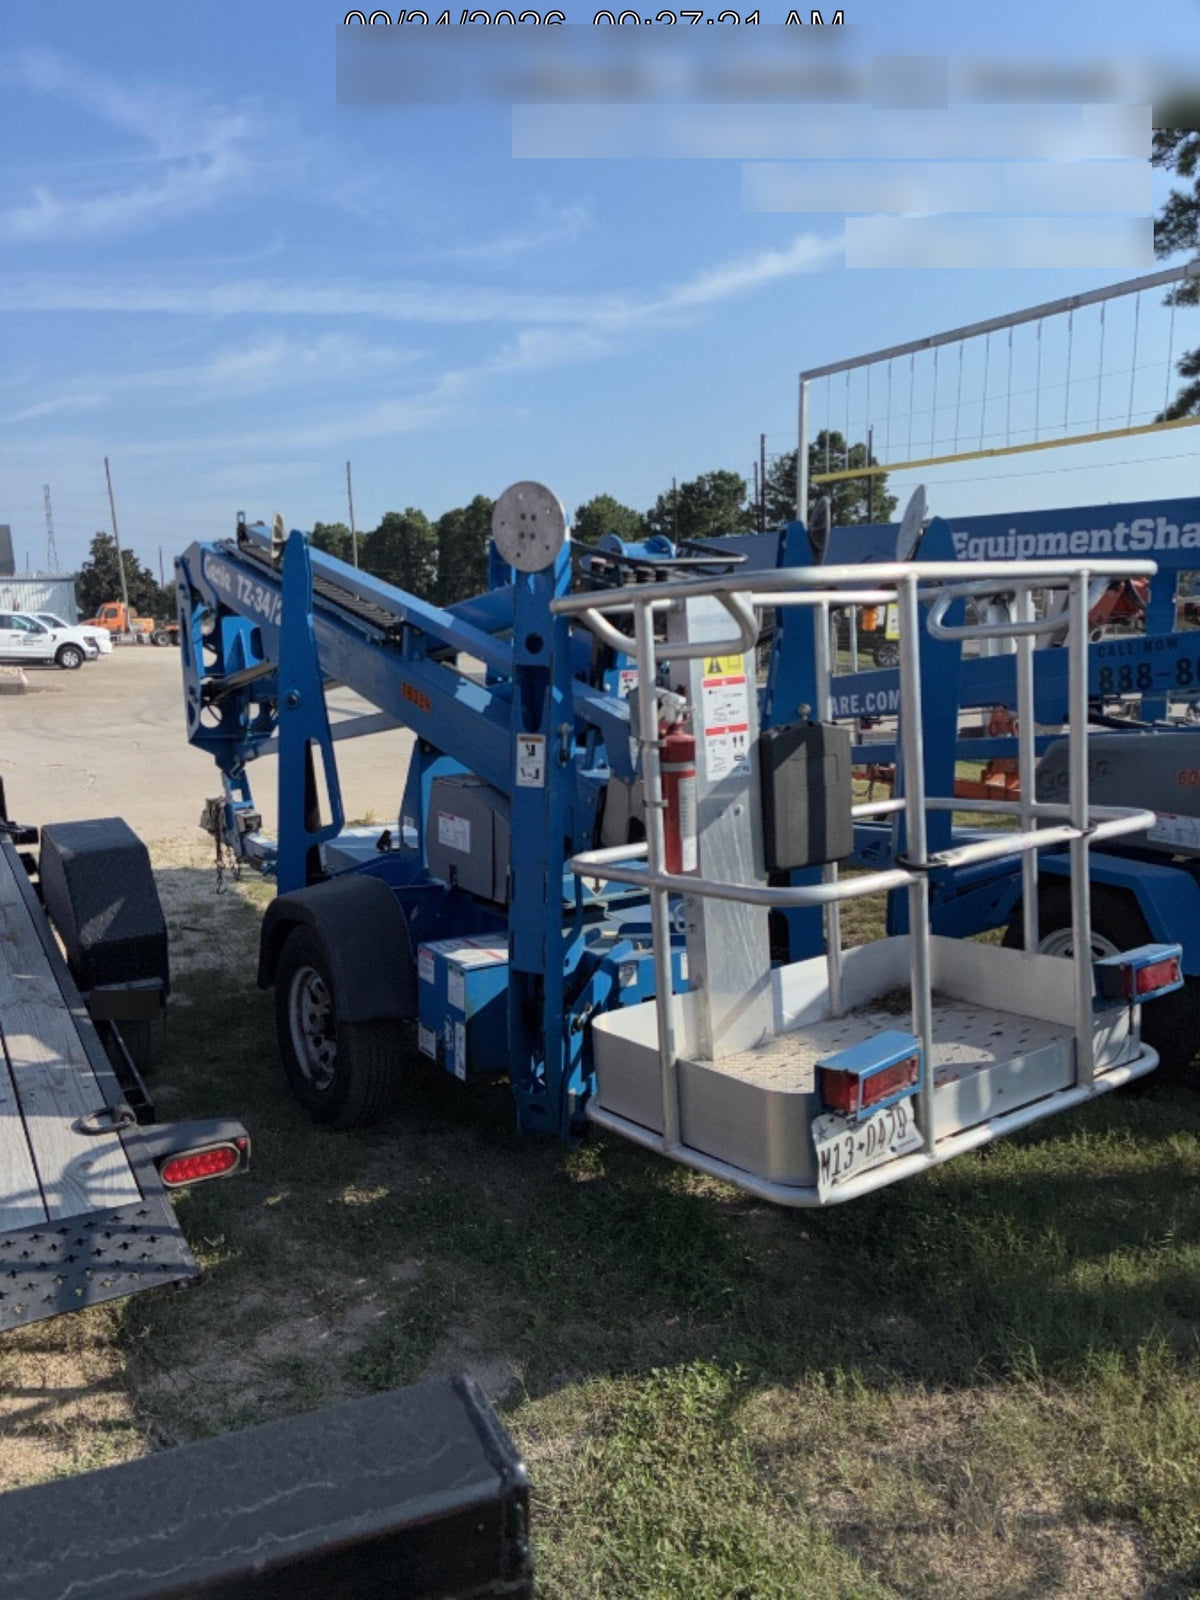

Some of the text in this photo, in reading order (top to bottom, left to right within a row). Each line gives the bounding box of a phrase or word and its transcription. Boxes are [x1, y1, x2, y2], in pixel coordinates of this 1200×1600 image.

[1097, 637, 1179, 658] CALL NOW
[1099, 657, 1200, 693] 888-8
[1178, 770, 1200, 785] 60
